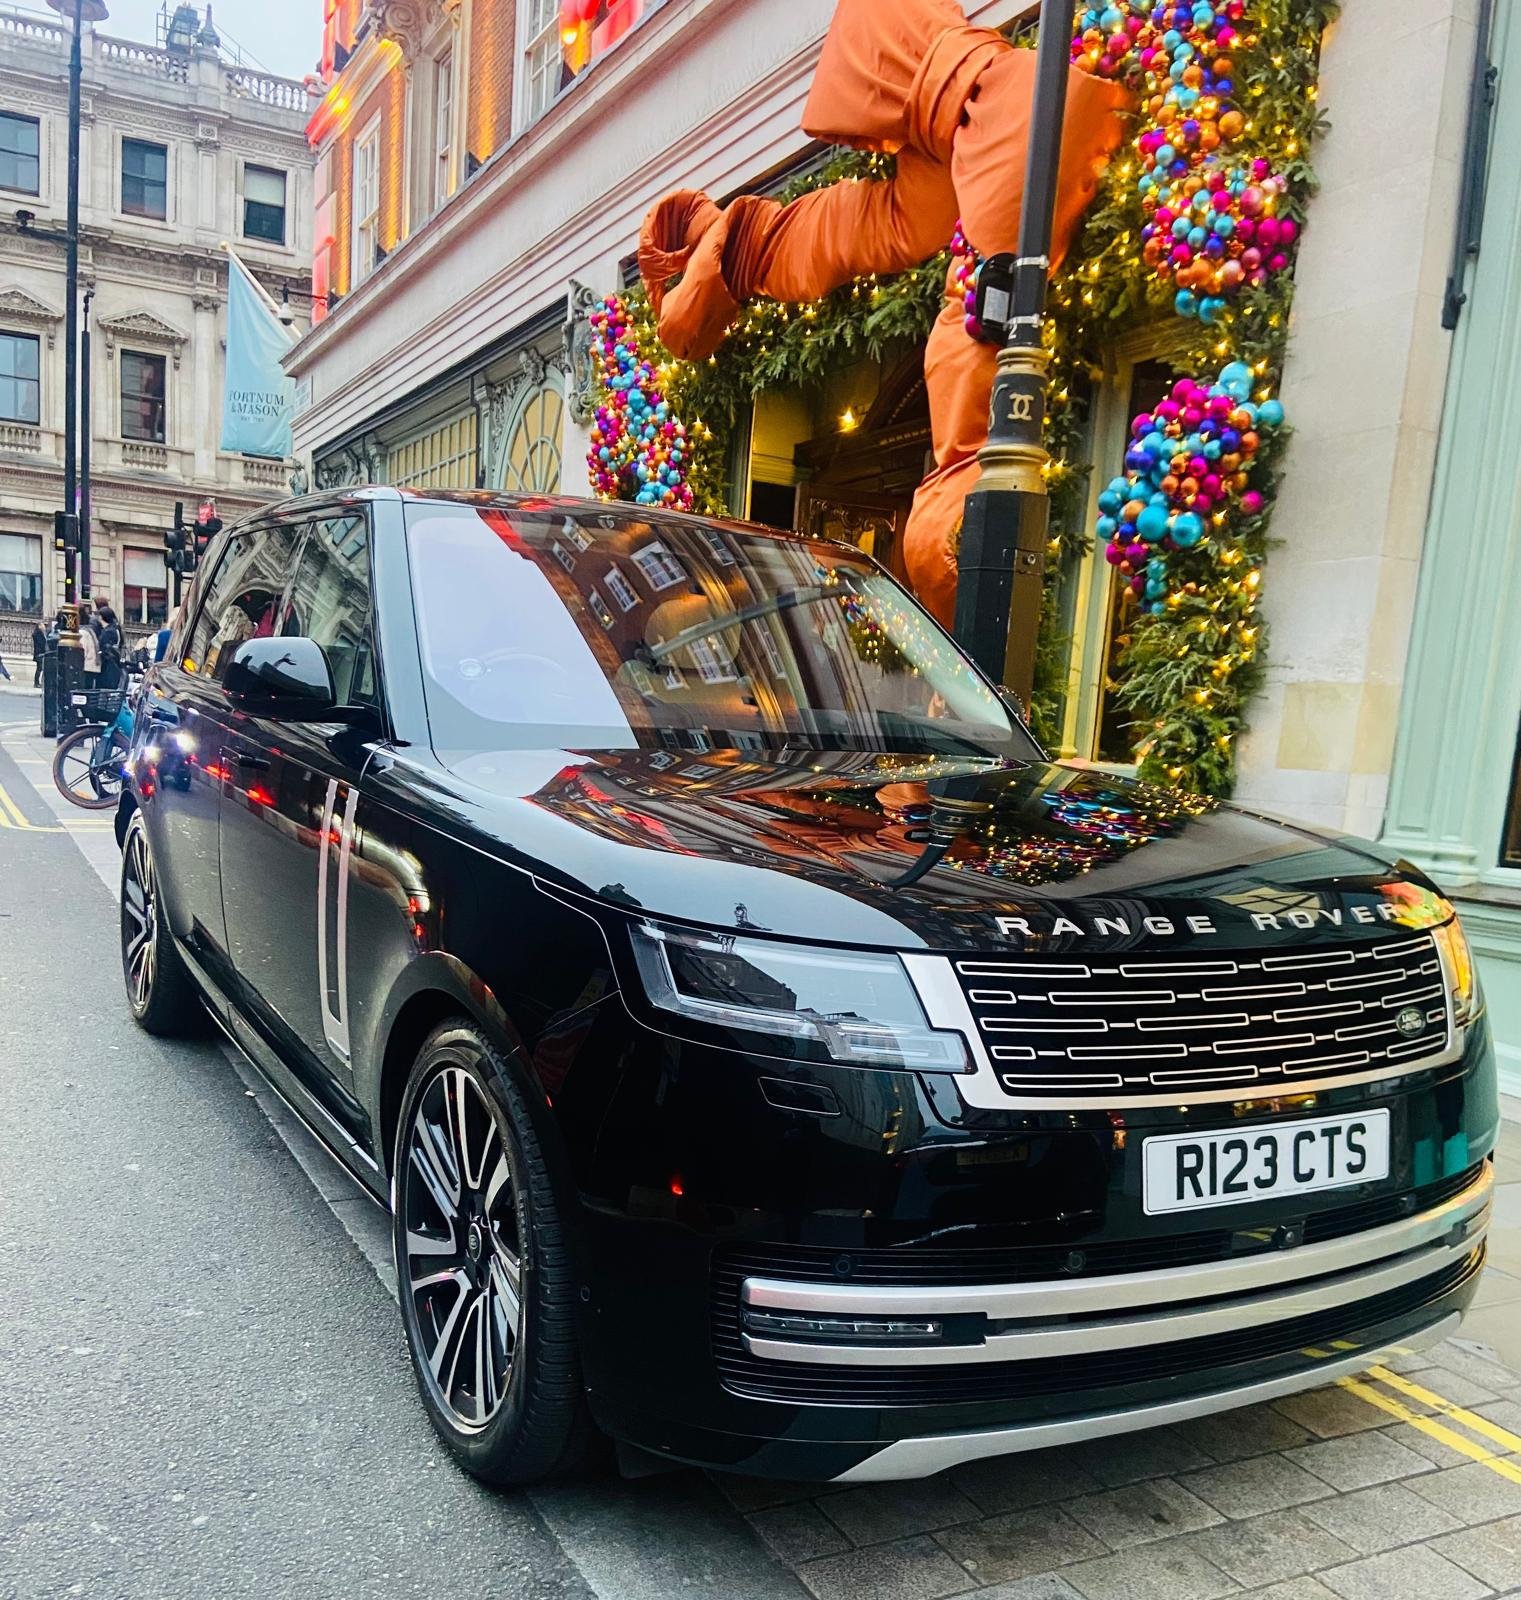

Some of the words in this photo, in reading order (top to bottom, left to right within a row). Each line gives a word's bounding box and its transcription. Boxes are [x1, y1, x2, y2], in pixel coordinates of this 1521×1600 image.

[994, 915, 1217, 936] RANGE
[1250, 903, 1403, 931] ROVER
[1176, 1135, 1278, 1200] R123
[1292, 1122, 1367, 1184] CTS
